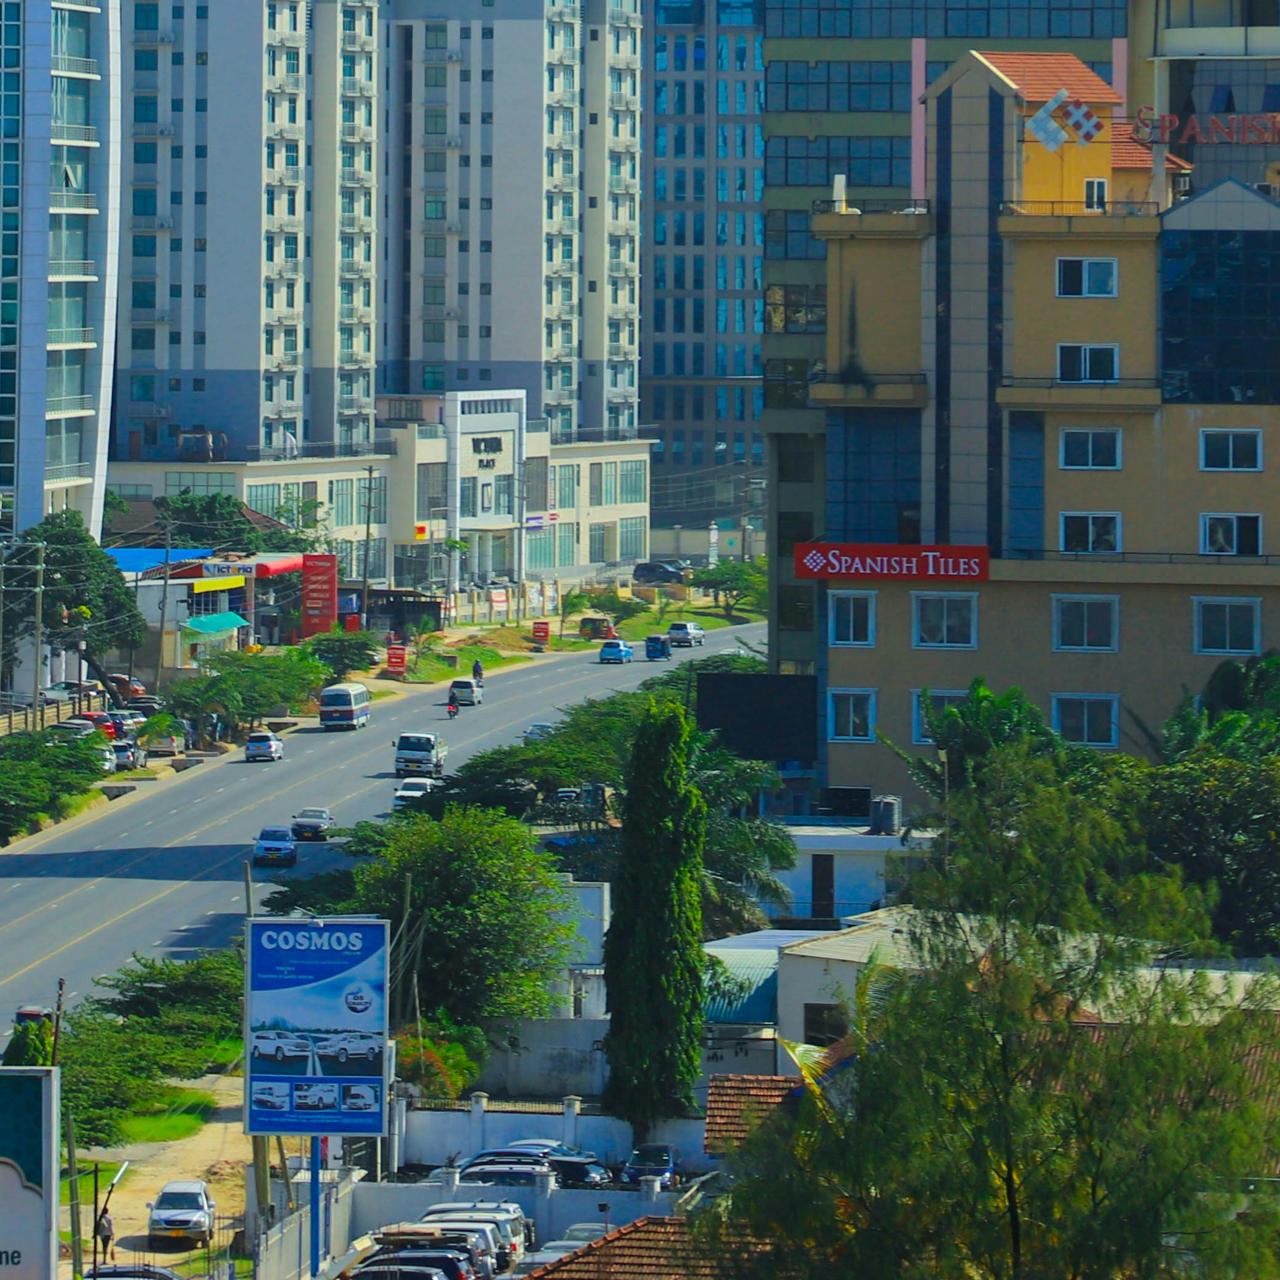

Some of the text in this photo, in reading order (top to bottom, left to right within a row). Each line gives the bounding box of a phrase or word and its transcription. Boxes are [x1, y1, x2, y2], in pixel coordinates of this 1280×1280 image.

[827, 550, 980, 576] SPANISH TILES
[261, 931, 363, 950] COSMOS
